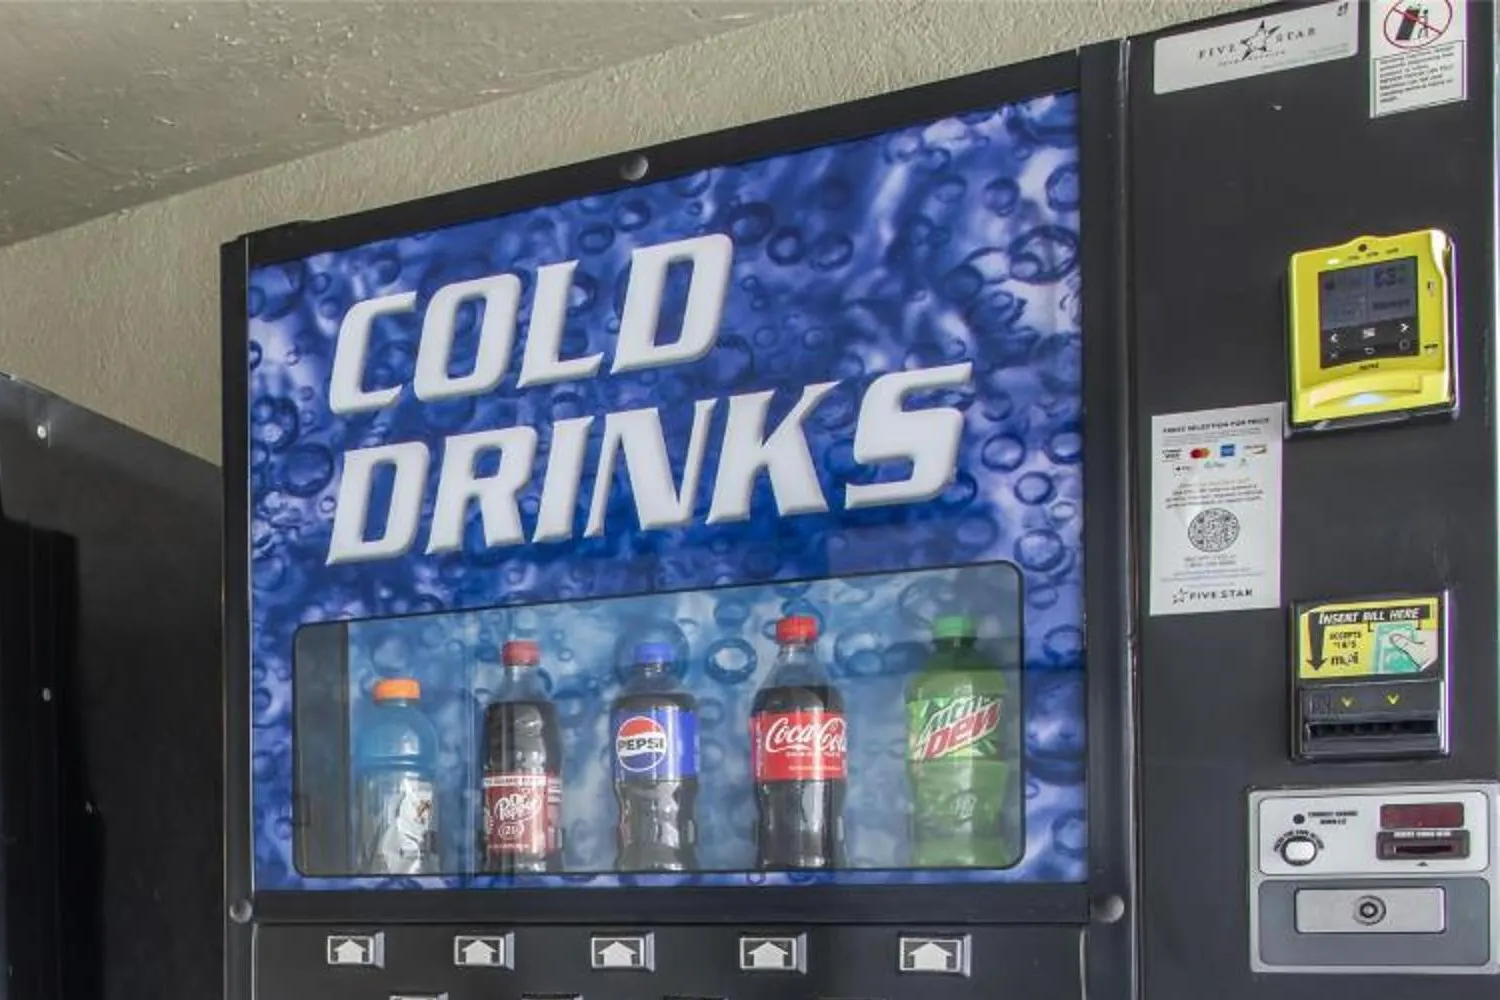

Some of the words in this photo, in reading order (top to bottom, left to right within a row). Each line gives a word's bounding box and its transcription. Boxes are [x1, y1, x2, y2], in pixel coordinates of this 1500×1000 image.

[329, 233, 734, 415] COLD
[326, 362, 974, 566] DRINKS
[1318, 612, 1360, 625] INSERT
[1362, 610, 1385, 621] BILL
[1389, 607, 1421, 620] HERE
[617, 737, 665, 752] PEPSI
